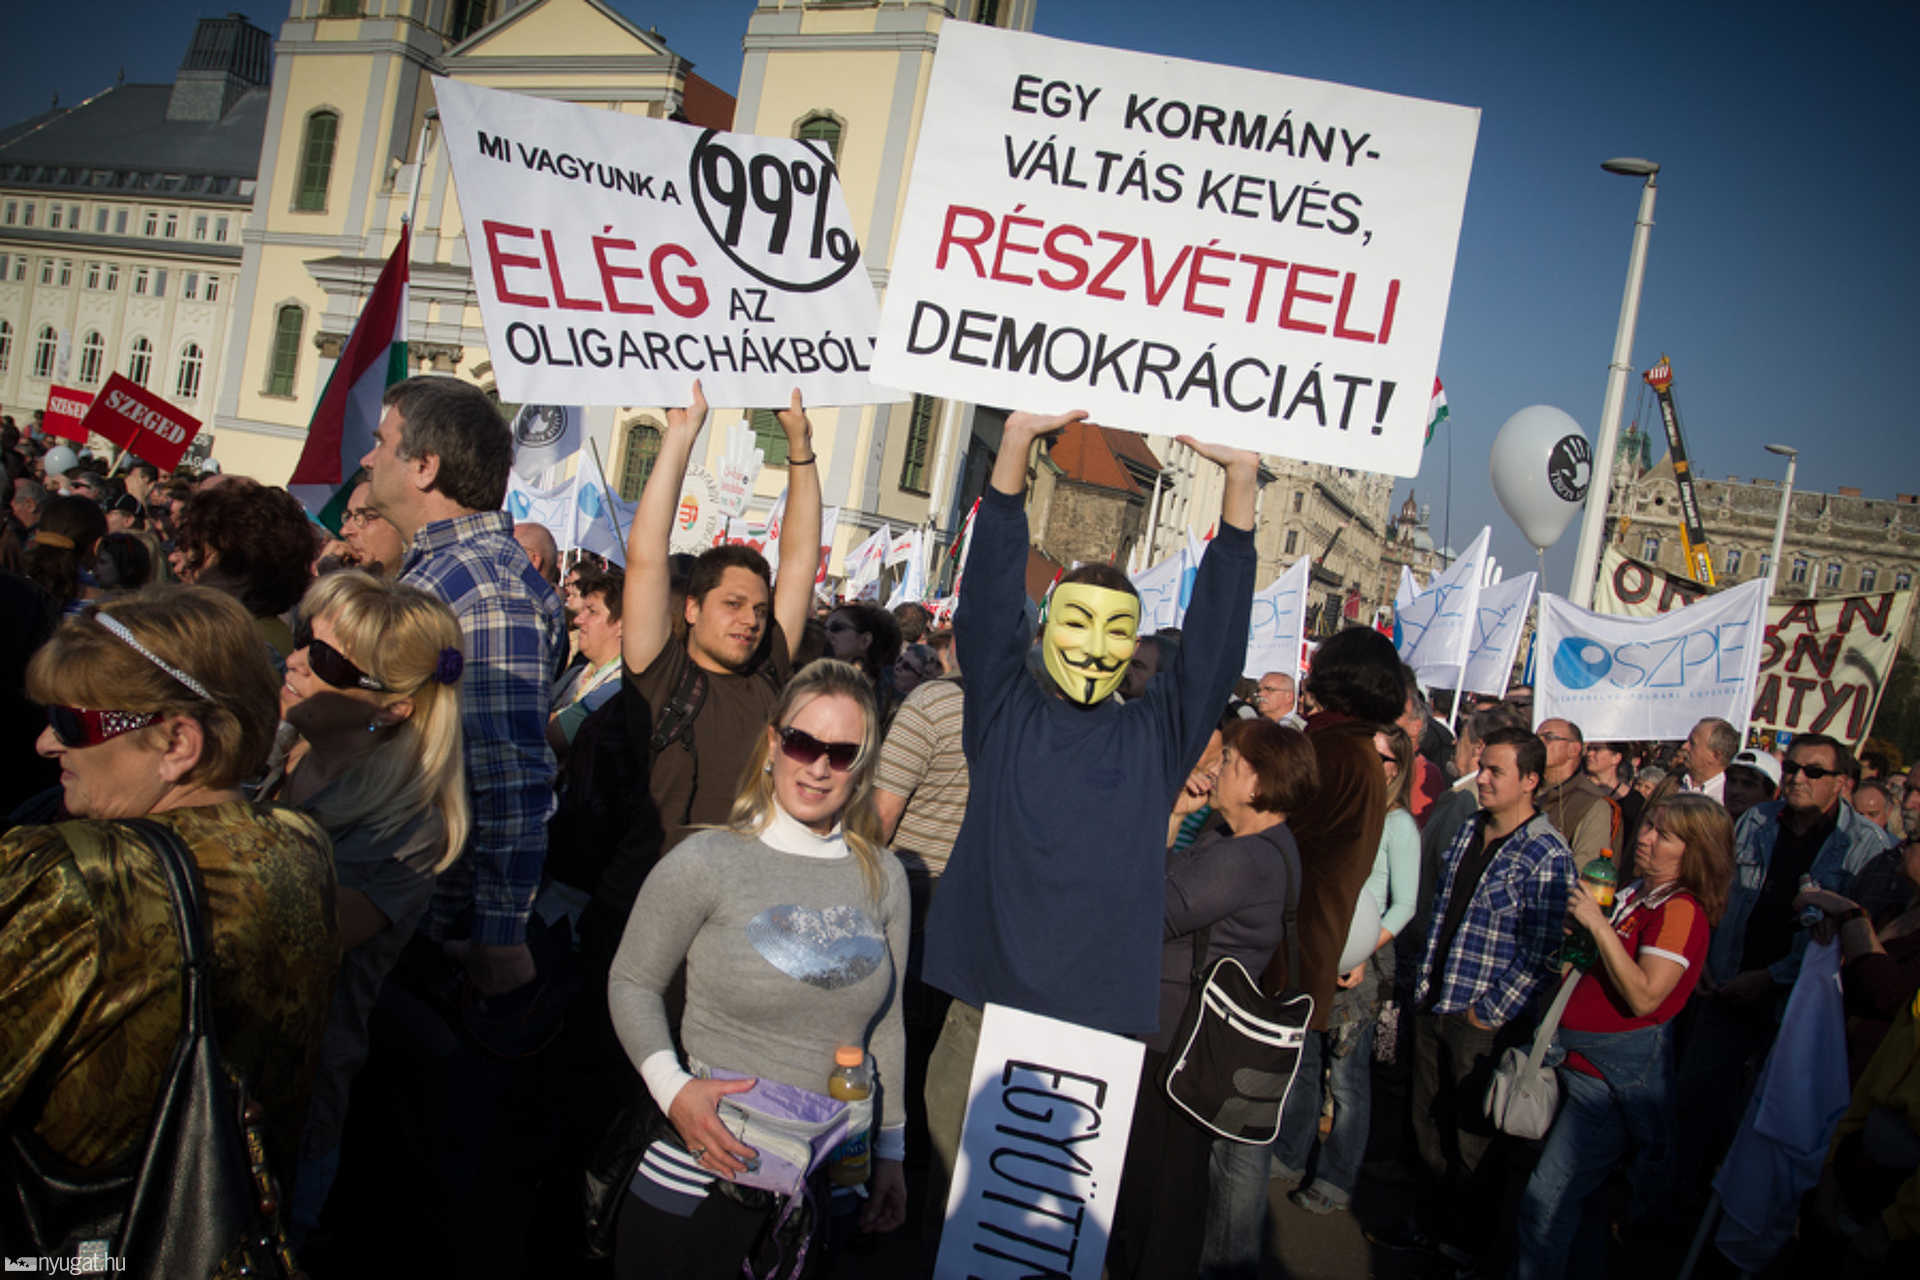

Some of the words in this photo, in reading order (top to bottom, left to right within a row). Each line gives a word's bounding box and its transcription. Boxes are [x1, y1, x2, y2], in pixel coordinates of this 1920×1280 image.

[1011, 74, 1101, 122] EGY
[1124, 94, 1381, 167] KORMÁNY-
[478, 130, 511, 163] MI
[517, 141, 655, 200] VAGYUNK
[661, 180, 681, 205] A
[701, 142, 853, 262] 99%
[1004, 135, 1184, 203] VÁLTÁS
[1197, 170, 1373, 247] KEVÉS,
[481, 219, 711, 319] ELÉG
[728, 288, 775, 323] AZ
[934, 203, 1401, 346] RÉSZVÉTELI
[103, 388, 187, 445] SZEGED
[905, 300, 1398, 436] DEMOKRÁCIÁT!
[1750, 674, 1869, 740] ATYI
